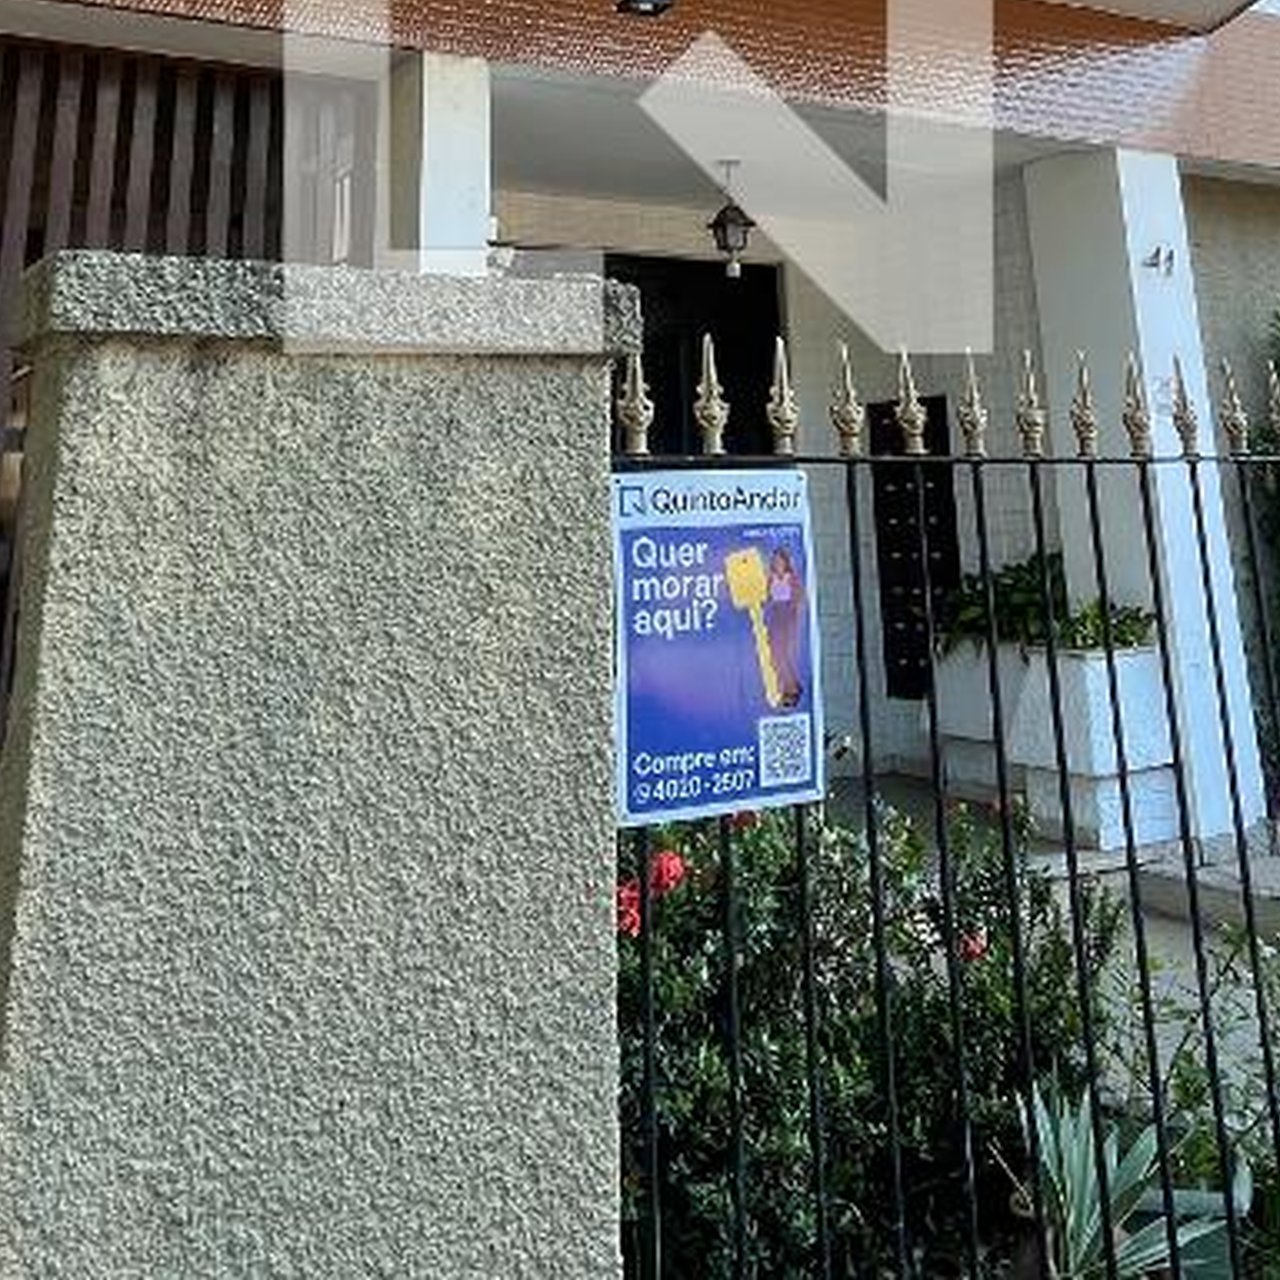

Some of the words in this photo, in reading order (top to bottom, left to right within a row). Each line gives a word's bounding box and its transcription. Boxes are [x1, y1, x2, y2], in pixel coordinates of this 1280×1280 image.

[651, 486, 801, 514] QuintoAndar
[632, 536, 709, 568] Quer
[632, 573, 724, 601] morar
[634, 599, 719, 640] aqui?
[634, 751, 716, 775] Compre
